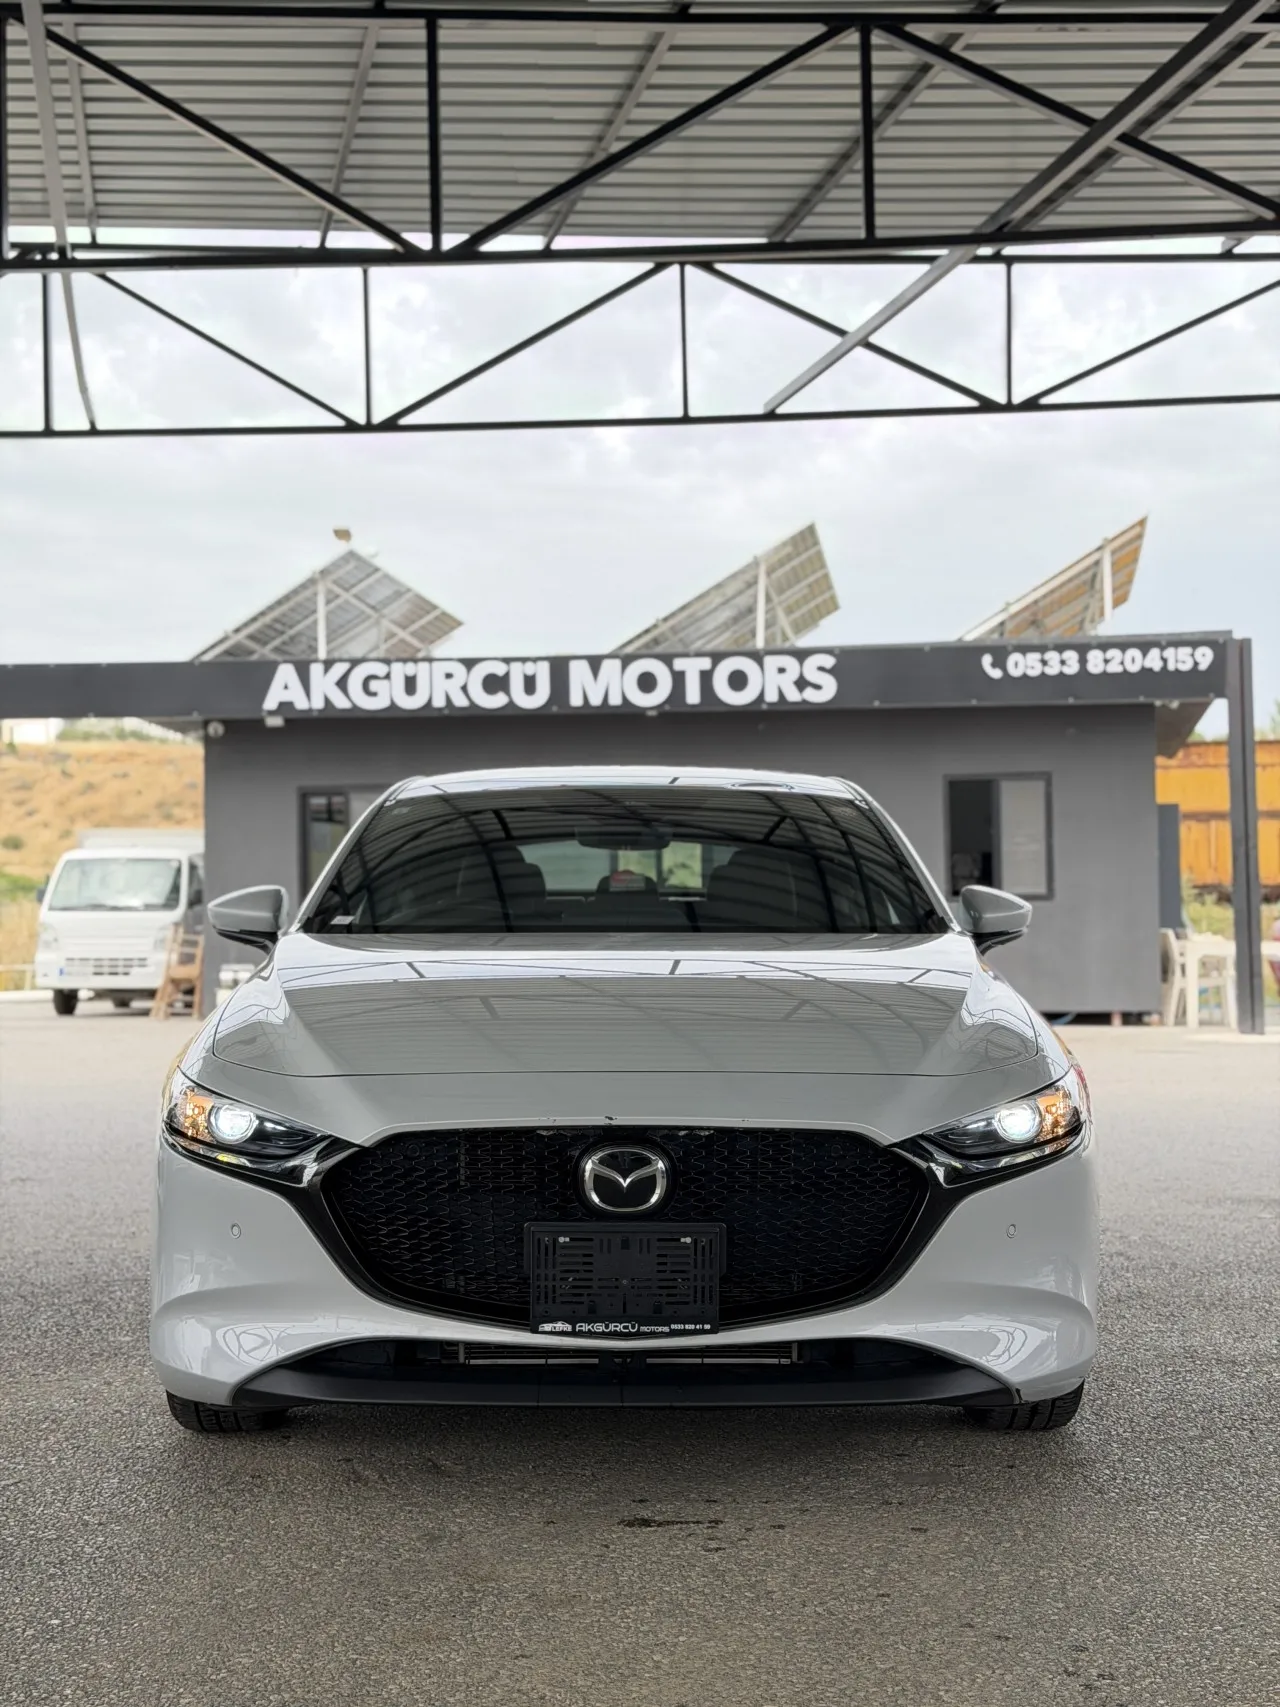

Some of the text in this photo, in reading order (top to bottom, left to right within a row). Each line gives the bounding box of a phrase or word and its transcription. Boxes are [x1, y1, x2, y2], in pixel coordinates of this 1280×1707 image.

[1006, 646, 1214, 678] 0533 8204159
[262, 653, 838, 711] AKGÜRCÜ MOTORS
[575, 1321, 639, 1333] AKGÜRCÜ
